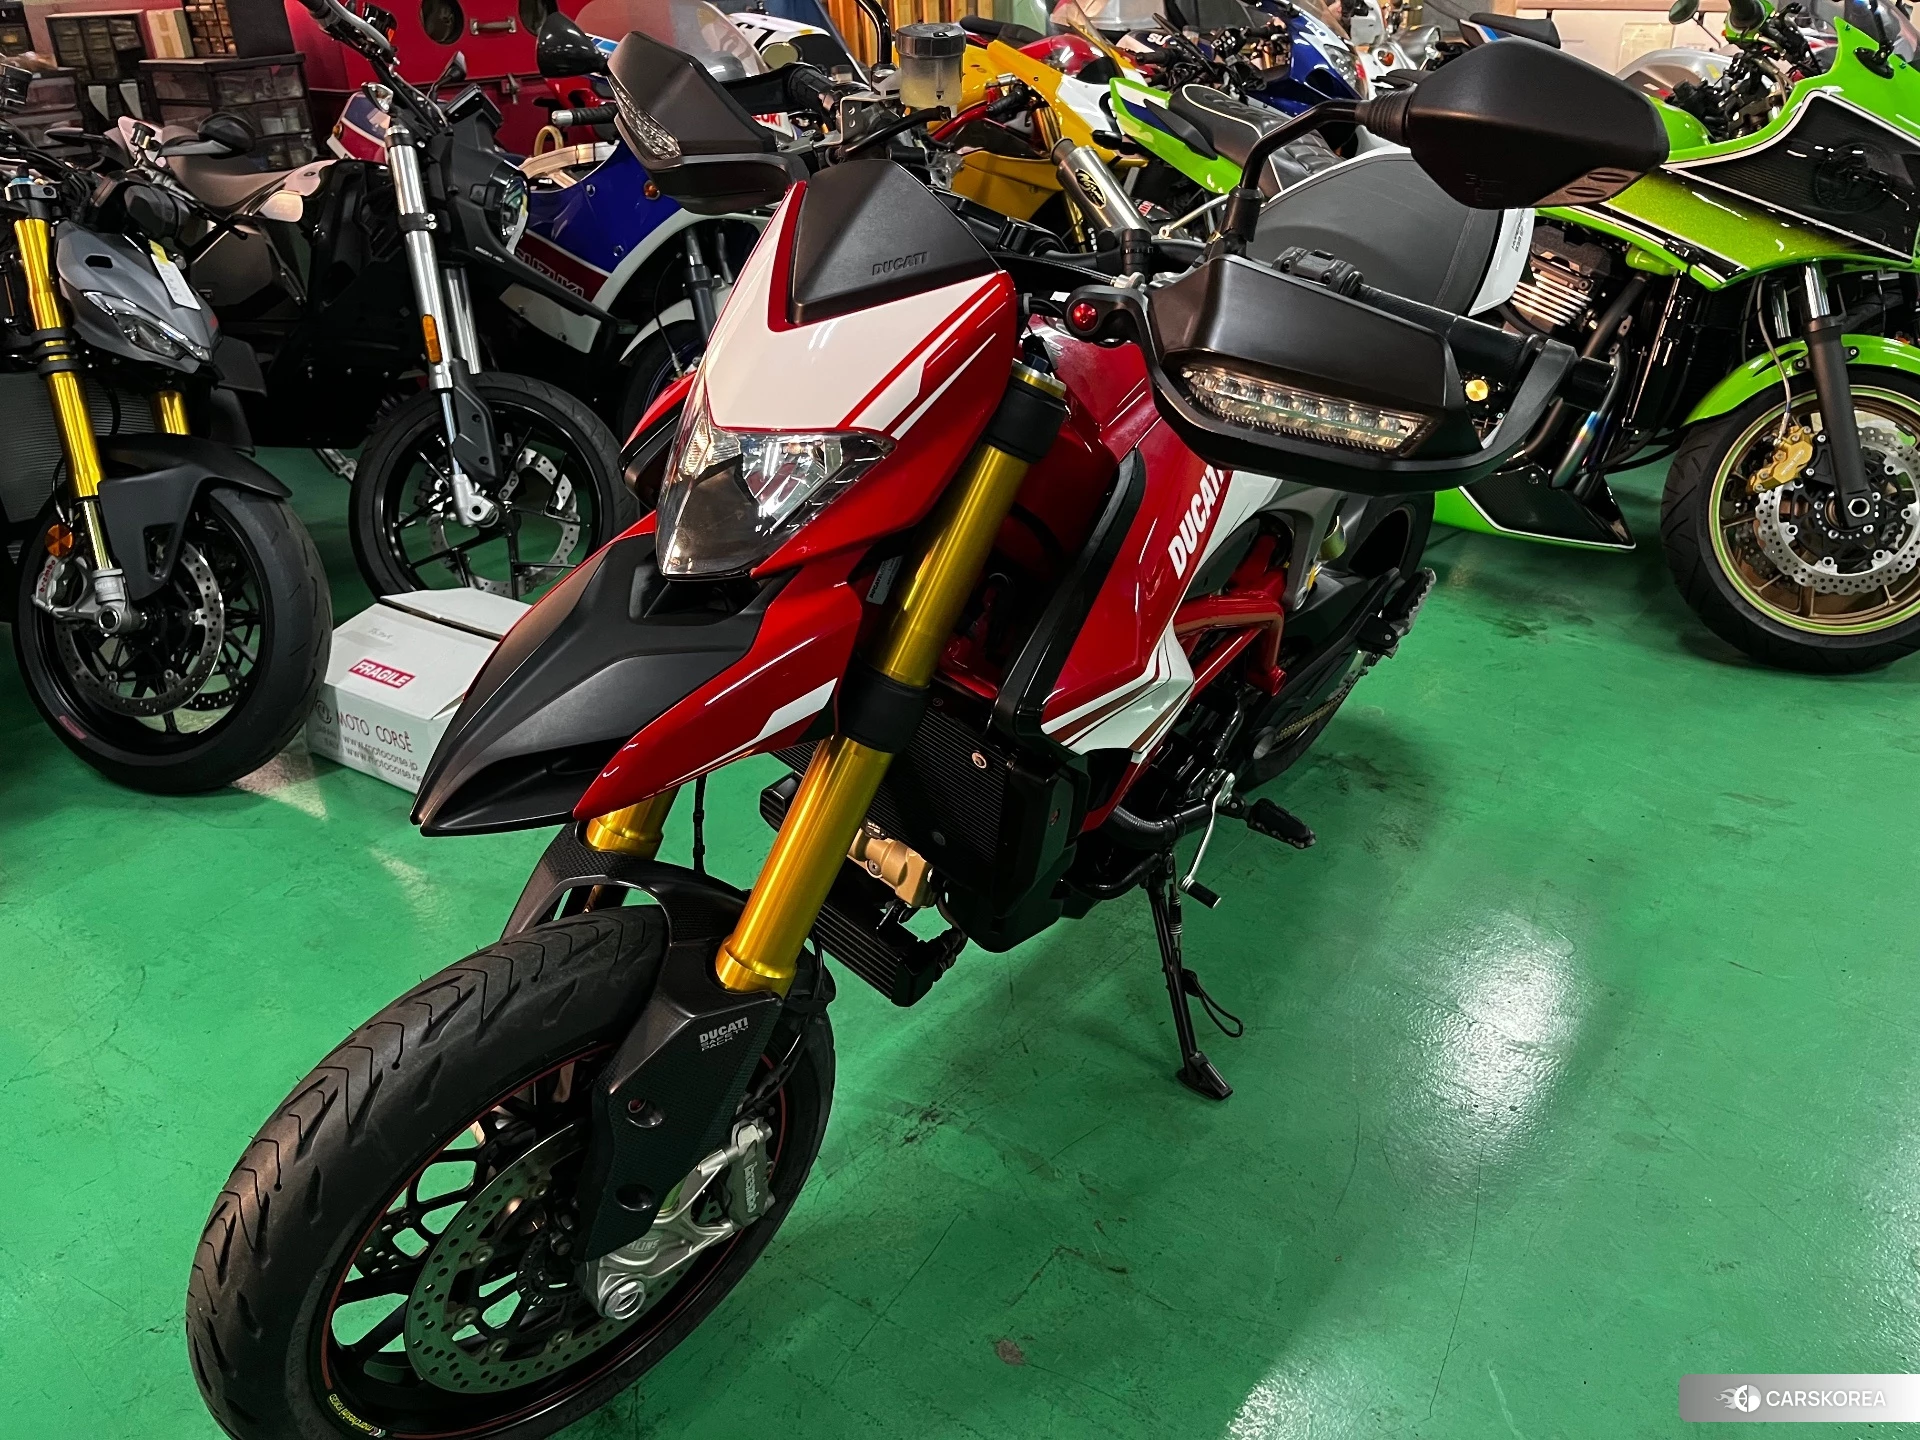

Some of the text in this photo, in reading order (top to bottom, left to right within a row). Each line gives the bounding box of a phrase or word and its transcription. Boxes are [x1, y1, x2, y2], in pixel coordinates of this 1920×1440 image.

[871, 251, 929, 276] DUCATI
[352, 661, 411, 687] FRAGILE
[336, 710, 370, 736] MOTO
[699, 1016, 749, 1044] DUCATI
